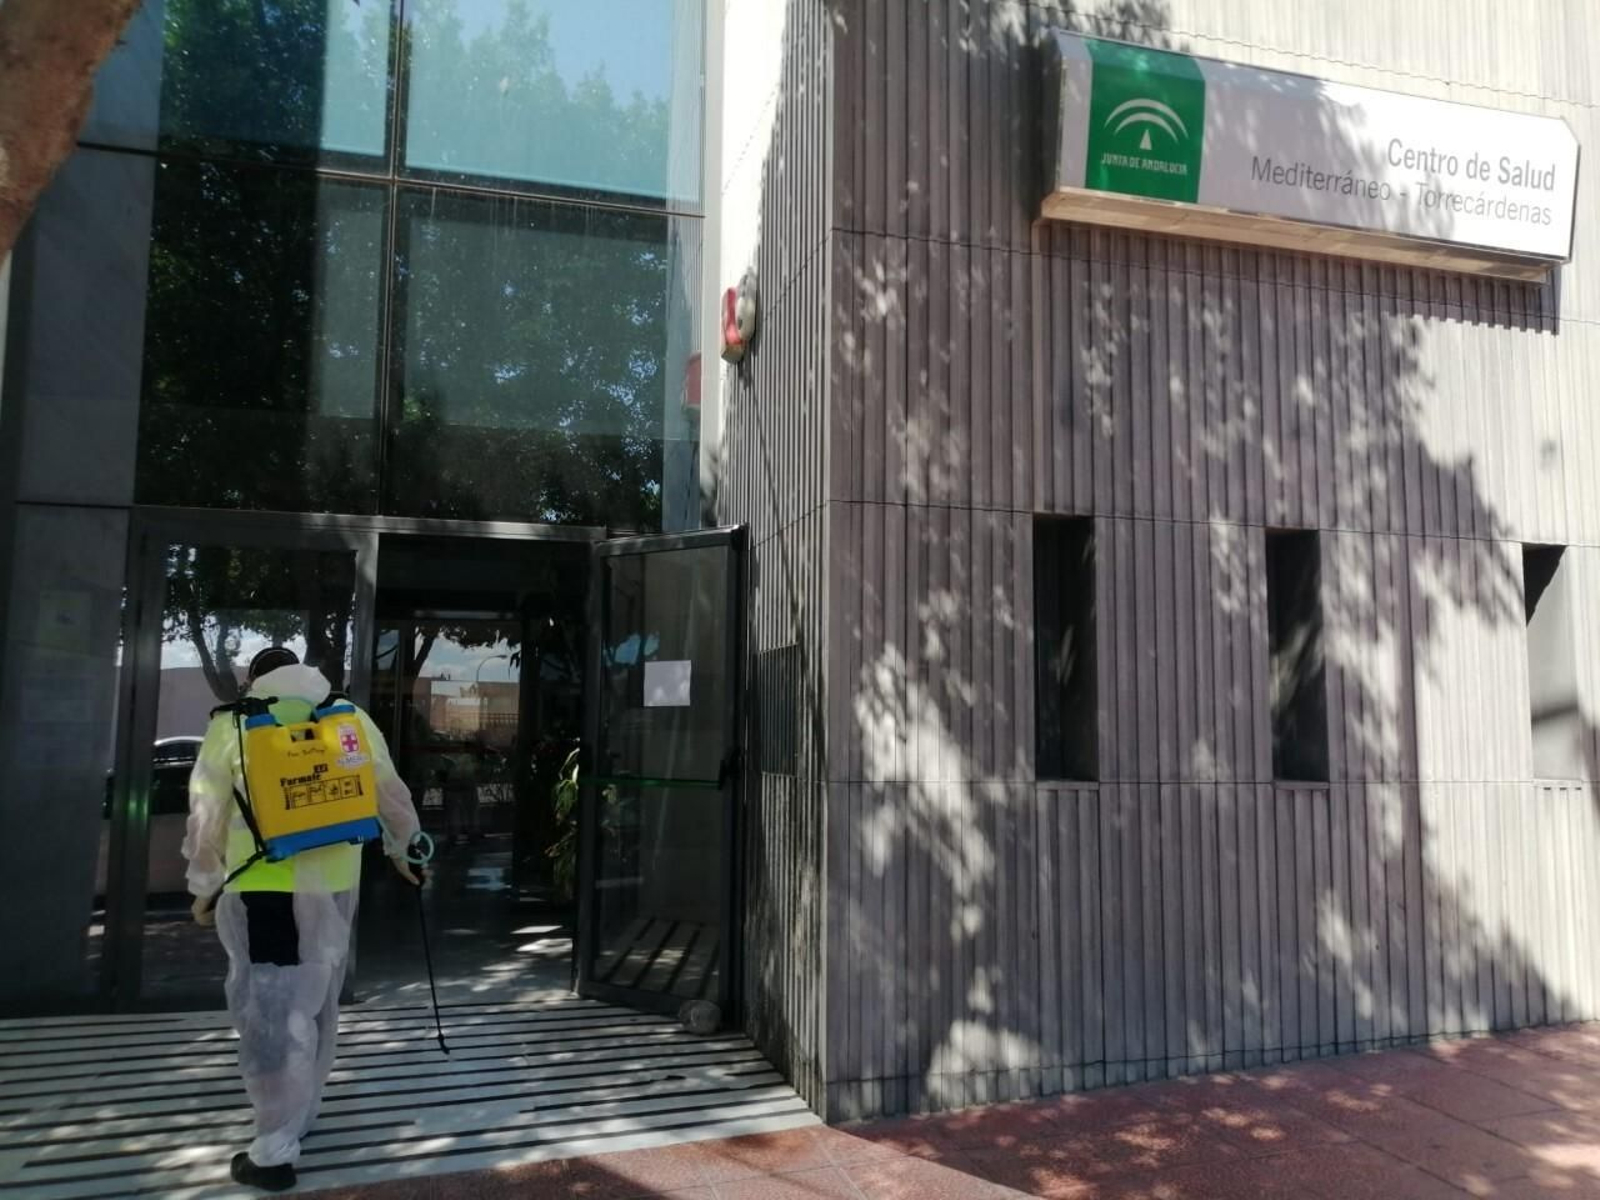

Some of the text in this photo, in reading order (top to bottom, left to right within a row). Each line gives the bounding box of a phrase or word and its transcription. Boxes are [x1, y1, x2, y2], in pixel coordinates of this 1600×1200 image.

[1101, 153, 1128, 167] JUNTA
[1129, 156, 1141, 168] DE
[1388, 138, 1555, 191] Centro de Salud
[1251, 156, 1391, 201] Mediterráneo
[1415, 181, 1552, 226] Torrecárdenas
